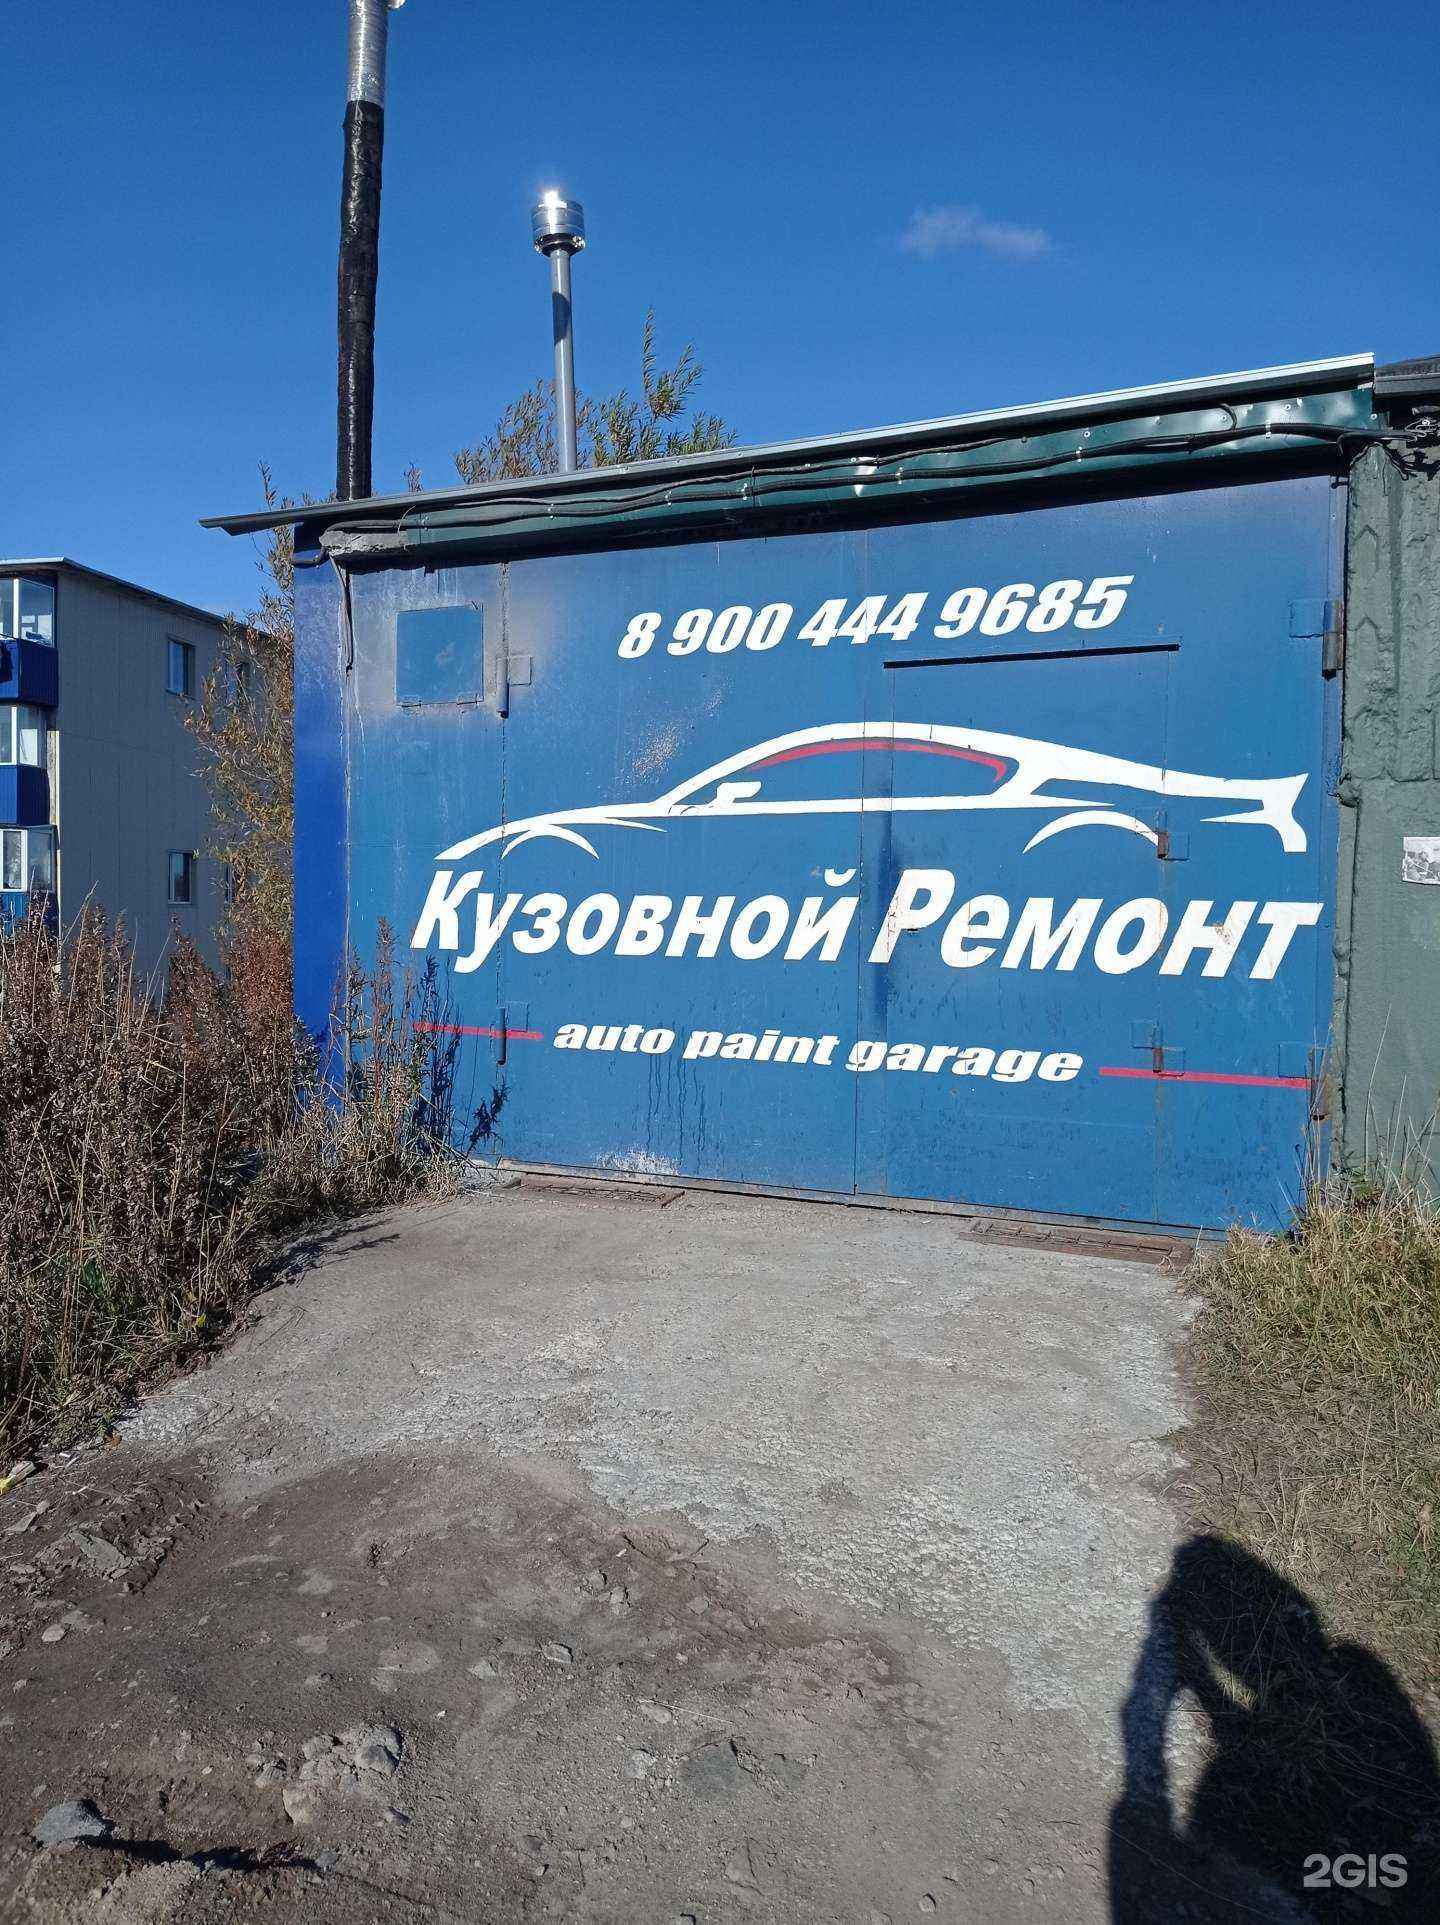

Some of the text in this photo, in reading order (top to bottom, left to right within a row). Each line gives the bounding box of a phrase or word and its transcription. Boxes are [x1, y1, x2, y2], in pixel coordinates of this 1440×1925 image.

[617, 574, 1135, 659] 8 900 444 9685
[409, 868, 1324, 980] Кузовной Ремонт
[553, 1022, 1084, 1083] auto paint garage
